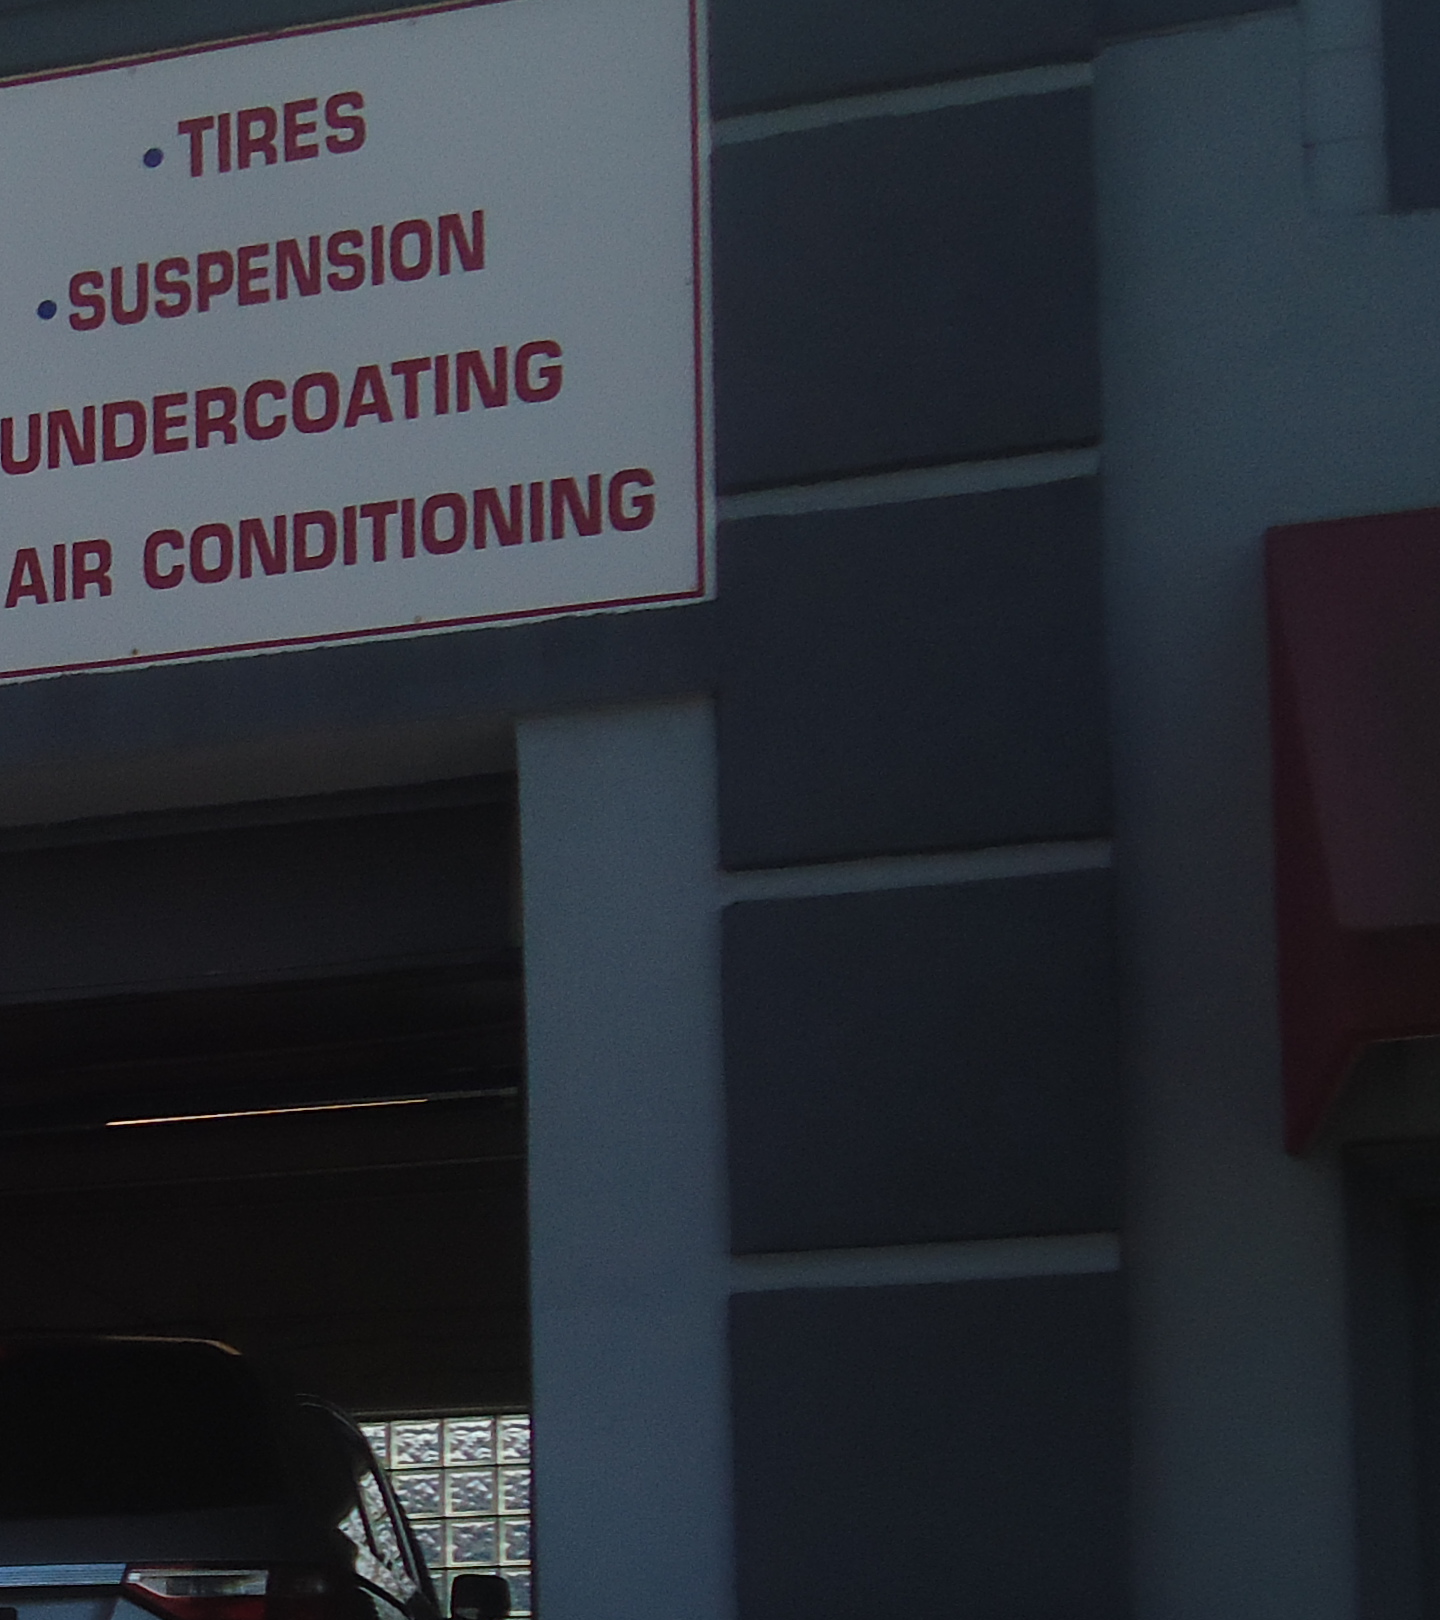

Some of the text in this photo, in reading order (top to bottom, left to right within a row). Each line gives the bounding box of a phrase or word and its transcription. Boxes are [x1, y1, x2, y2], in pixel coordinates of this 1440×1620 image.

[177, 90, 367, 178] TIRES
[67, 209, 486, 331] SUSPENSION
[3, 467, 657, 609] AIR CONDITIONING
